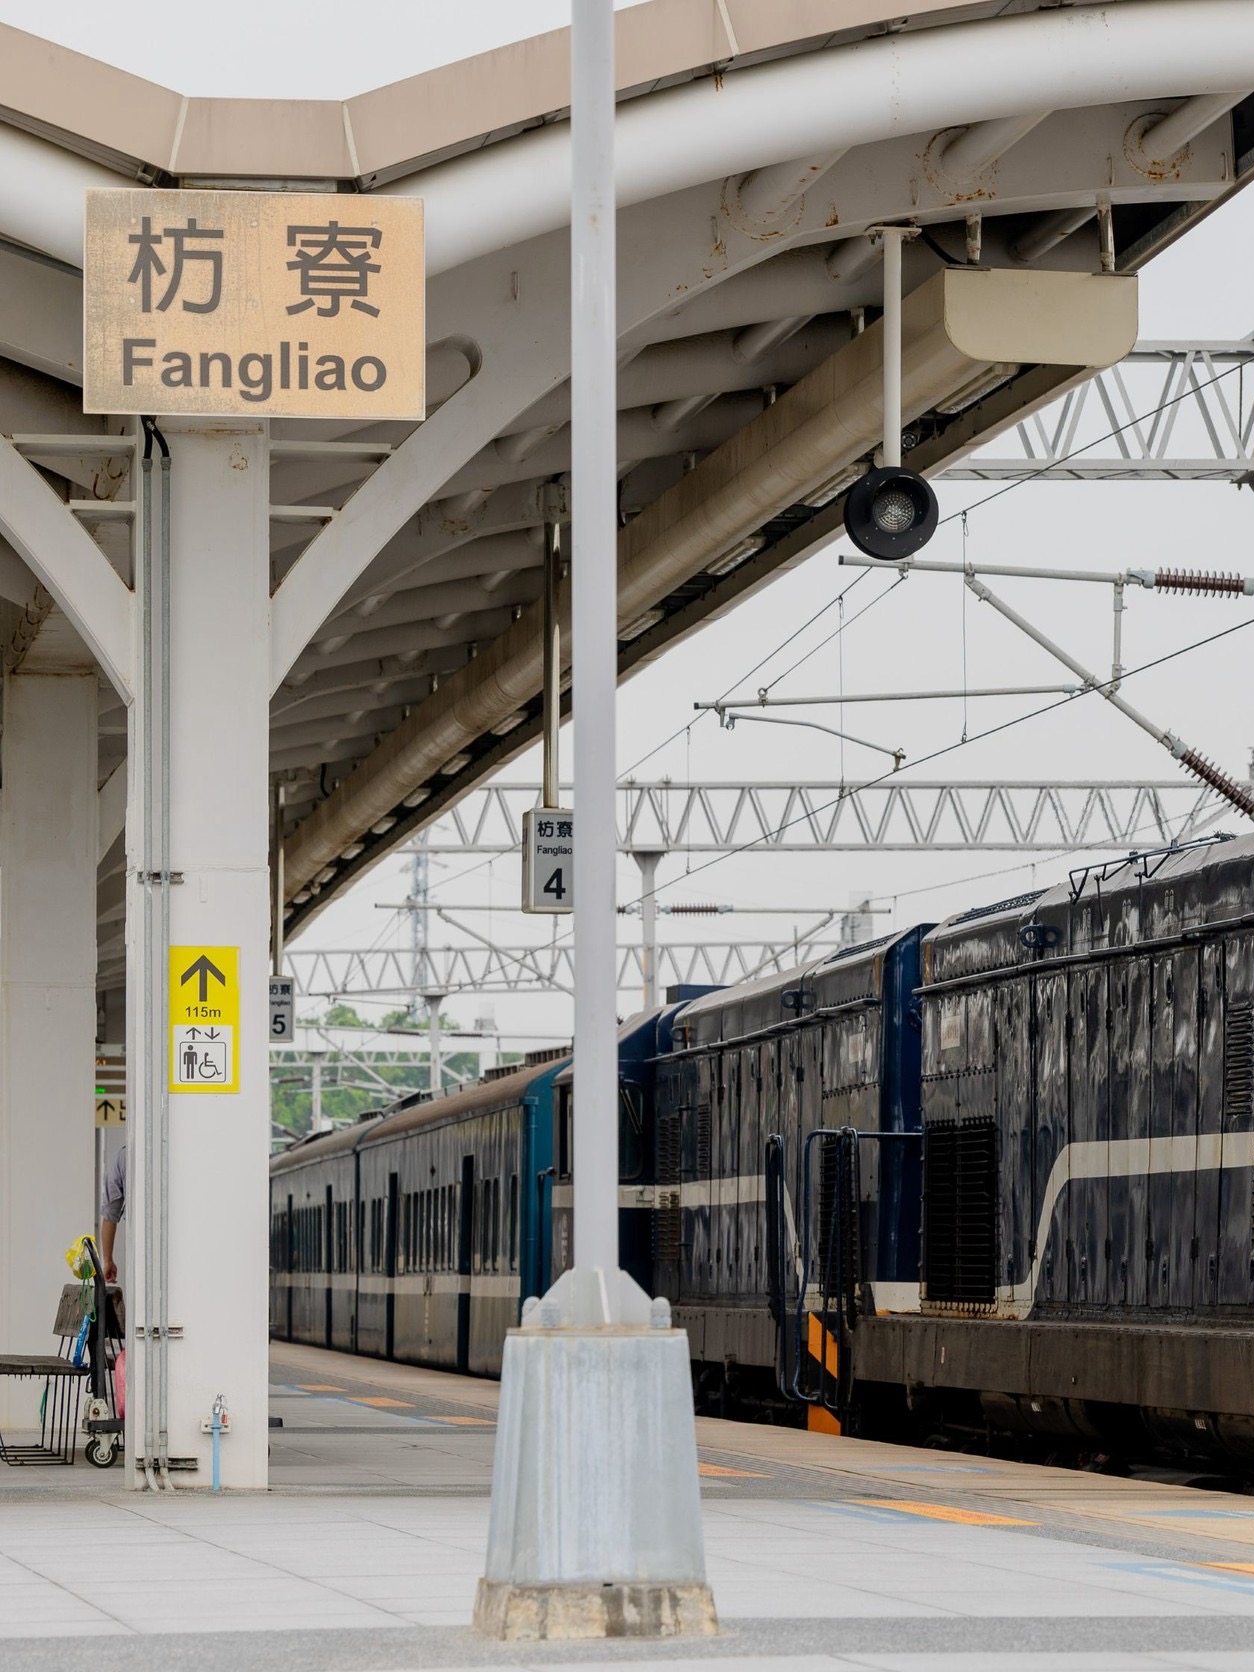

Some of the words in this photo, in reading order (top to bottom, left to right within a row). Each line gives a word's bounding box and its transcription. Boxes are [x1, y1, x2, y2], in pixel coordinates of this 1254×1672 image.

[127, 215, 383, 319] 枋寮
[122, 338, 388, 402] Fangliao
[537, 820, 573, 838] 枋寮
[536, 844, 573, 857] Fangliao
[543, 867, 566, 900] 4
[185, 1006, 221, 1018] 115m
[270, 999, 291, 1007] angliao
[272, 1013, 286, 1035] 5
